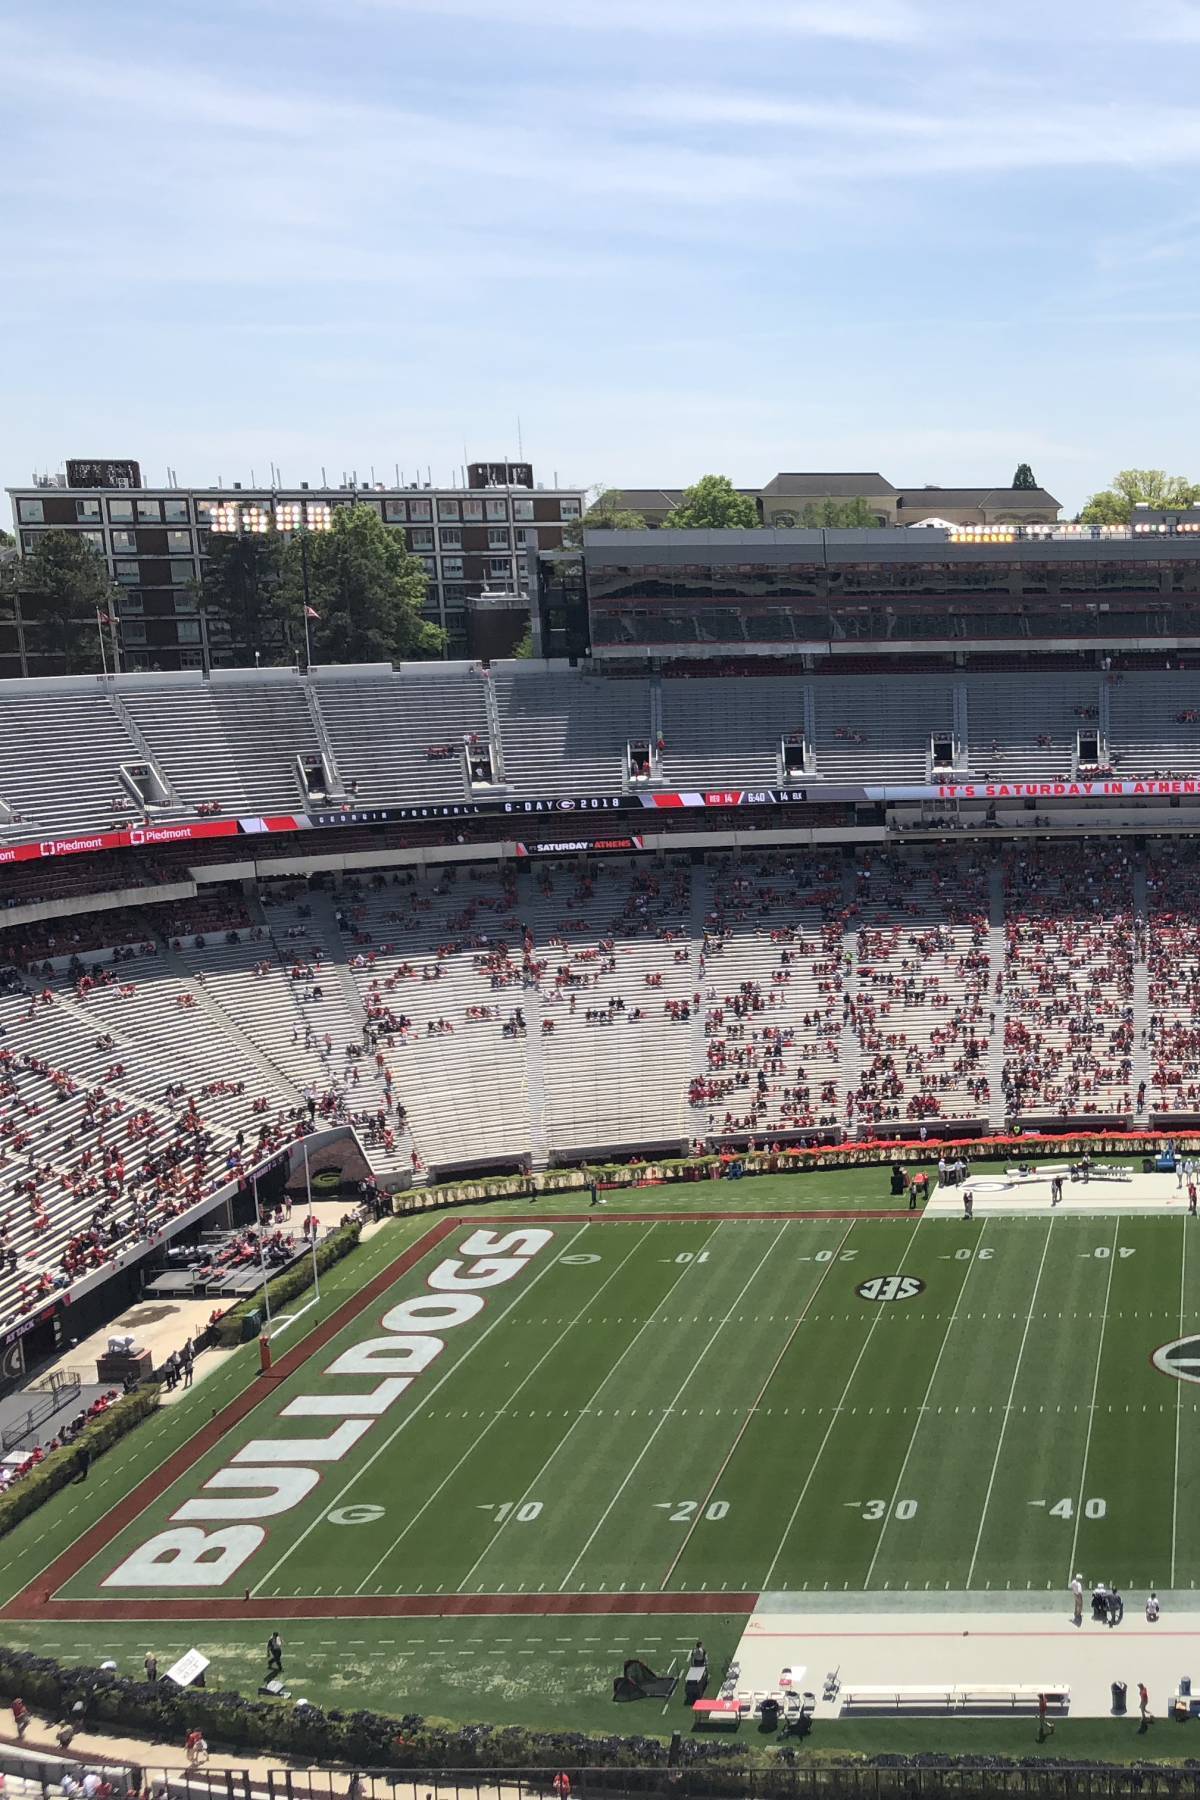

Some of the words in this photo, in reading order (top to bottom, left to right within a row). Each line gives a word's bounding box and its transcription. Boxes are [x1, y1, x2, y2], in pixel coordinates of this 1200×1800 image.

[780, 791, 788, 801] 14
[939, 785, 975, 797] IT'S
[985, 783, 1094, 796] SATURDAY
[1103, 782, 1123, 794] IN
[504, 801, 553, 812] G-DAY
[580, 798, 620, 808] 2018
[724, 793, 733, 803] 14
[319, 812, 387, 823] GEORGIA
[401, 806, 479, 817] FOOTBALL
[146, 828, 191, 841] Piedmont
[56, 838, 102, 852] Piedmont
[537, 842, 588, 852] SATURDAY
[674, 1251, 712, 1264] 10
[814, 1250, 860, 1262] 20
[954, 1248, 995, 1260] 30
[1093, 1246, 1136, 1259] 40
[859, 1275, 921, 1300] SEC
[100, 1228, 554, 1587] BULLDOGS
[327, 1504, 386, 1526] G
[494, 1501, 545, 1523] 10
[668, 1501, 731, 1522] 20
[862, 1500, 918, 1520] 30
[1049, 1498, 1107, 1520] 40
